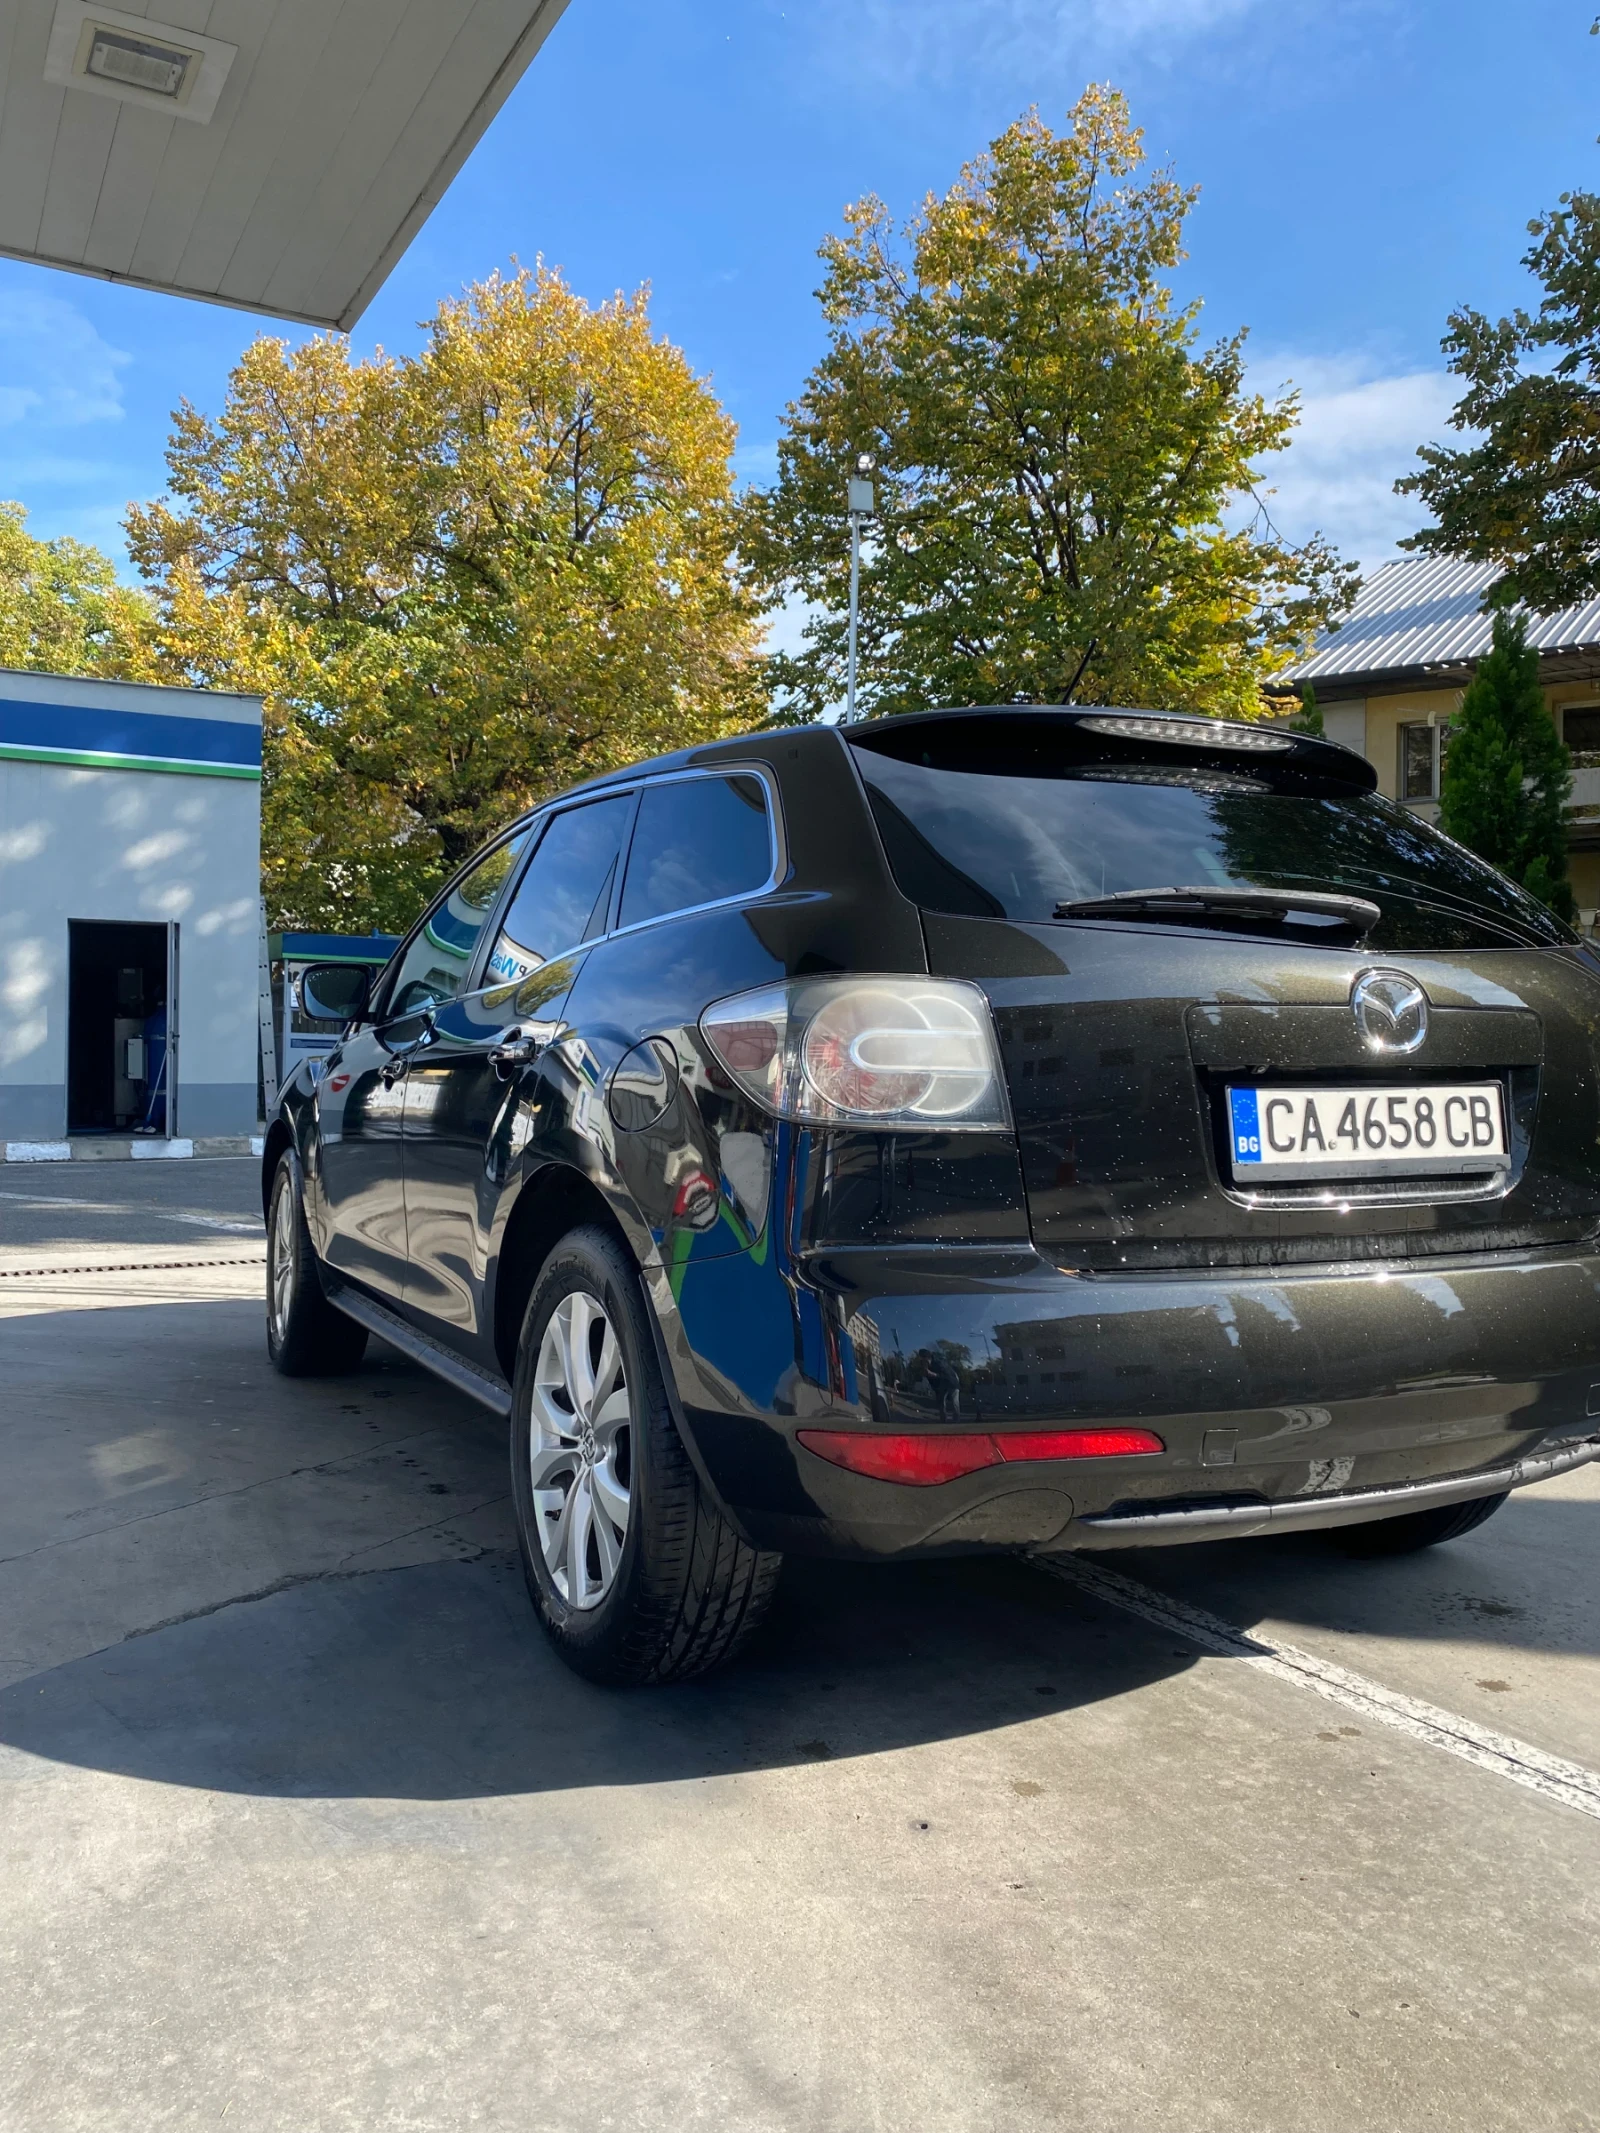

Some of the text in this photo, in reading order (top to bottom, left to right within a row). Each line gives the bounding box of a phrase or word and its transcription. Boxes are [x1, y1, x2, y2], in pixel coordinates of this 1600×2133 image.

[1265, 1095, 1495, 1152] CA 4658 CB
[1238, 1136, 1259, 1153] BG
